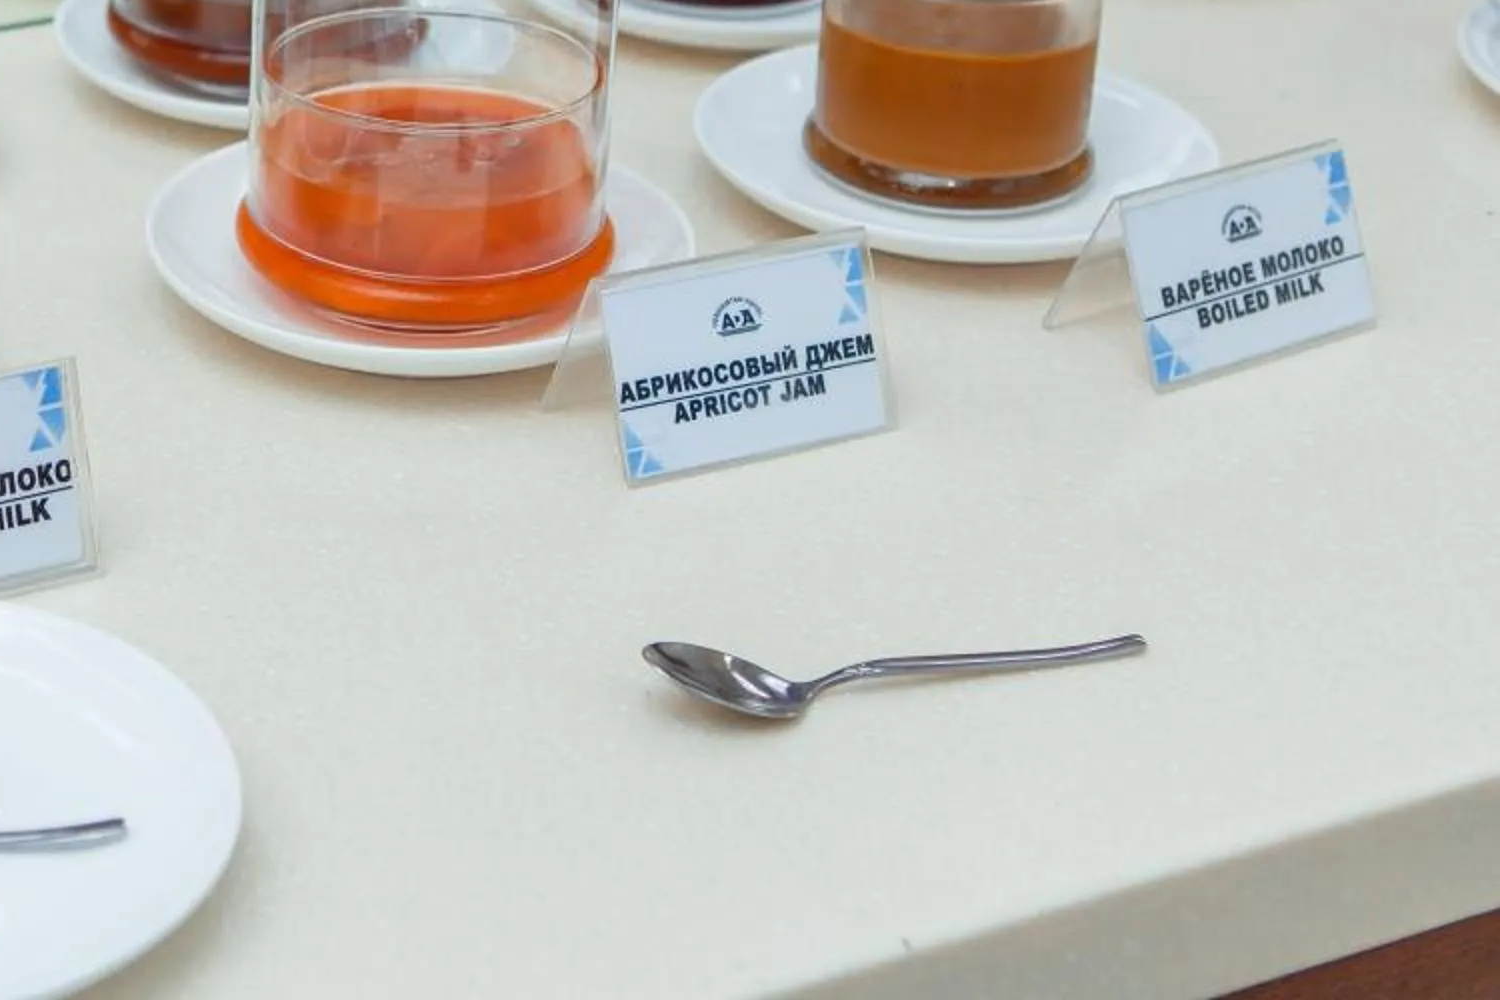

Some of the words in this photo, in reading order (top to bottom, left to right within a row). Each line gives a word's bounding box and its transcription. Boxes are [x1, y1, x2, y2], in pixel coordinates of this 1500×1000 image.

[1160, 262, 1256, 308] ВАРЁНОЕ
[1260, 235, 1344, 278] МОЛОКО
[1197, 288, 1270, 329] BOILED
[1275, 272, 1325, 305] MILK
[620, 344, 798, 404] АБРИКОСОВЫЙ
[805, 333, 875, 371] ДЖЕМ
[674, 384, 771, 424] APRICOT
[780, 373, 826, 402] JAM
